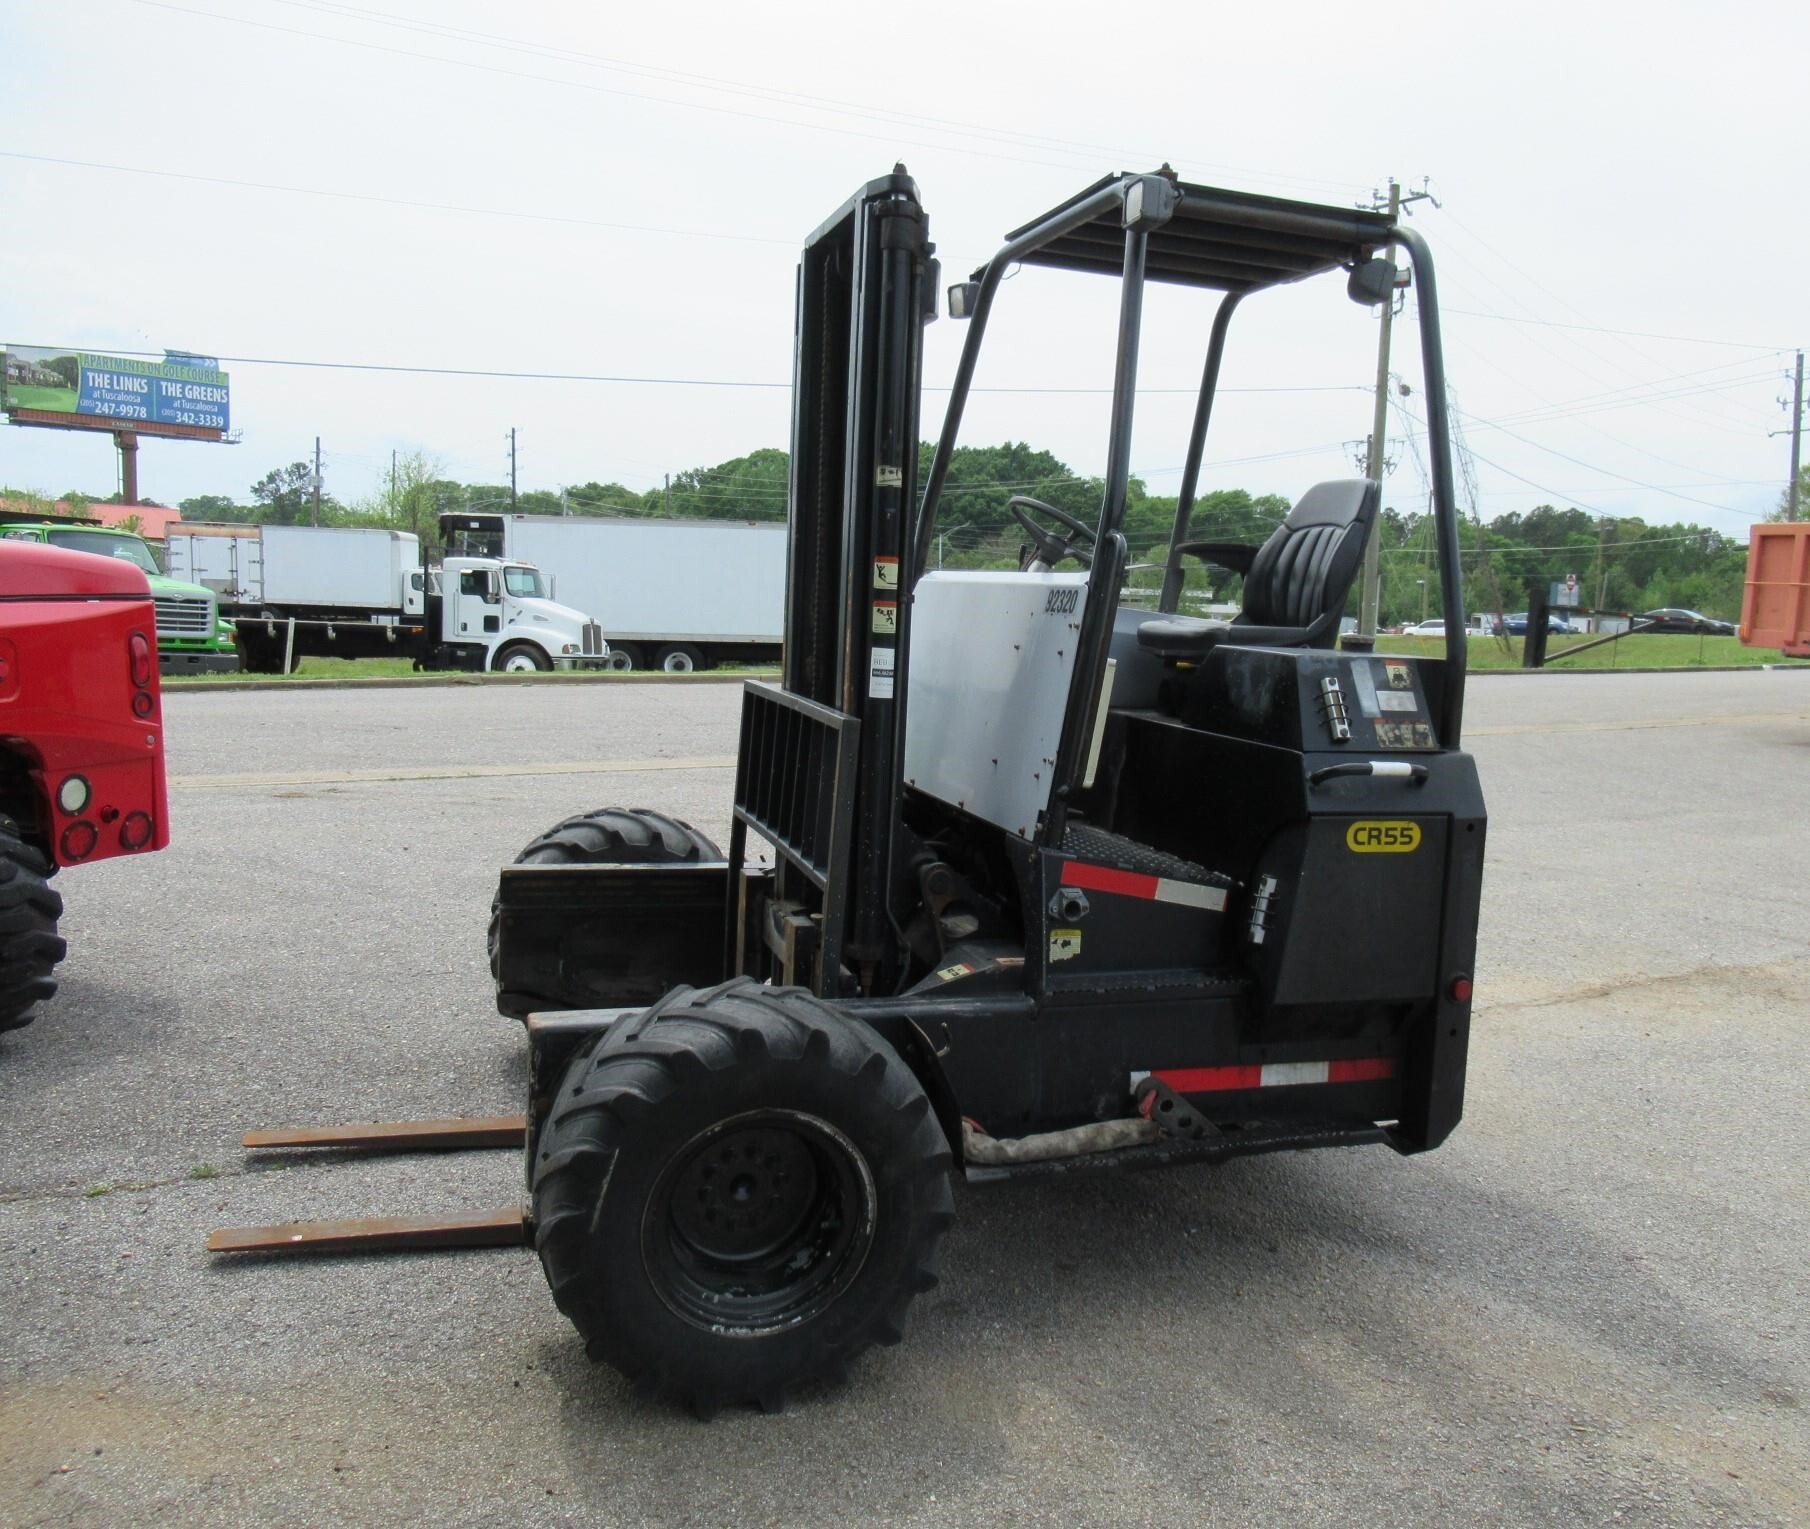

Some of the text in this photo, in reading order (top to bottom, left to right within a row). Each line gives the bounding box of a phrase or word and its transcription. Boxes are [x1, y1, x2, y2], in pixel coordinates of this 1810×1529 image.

[84, 355, 219, 383] APARTMENTS ON GOLF COURSE
[87, 372, 148, 393] THE LINKS
[160, 381, 228, 403] THE GREENS
[92, 389, 141, 403] at Tuscaloosa
[95, 402, 147, 418] 247-9978
[173, 400, 218, 412] at Tuscaloosa
[176, 411, 224, 428] 342-3339
[1045, 589, 1079, 614] 92320
[1353, 827, 1414, 846] CR55
